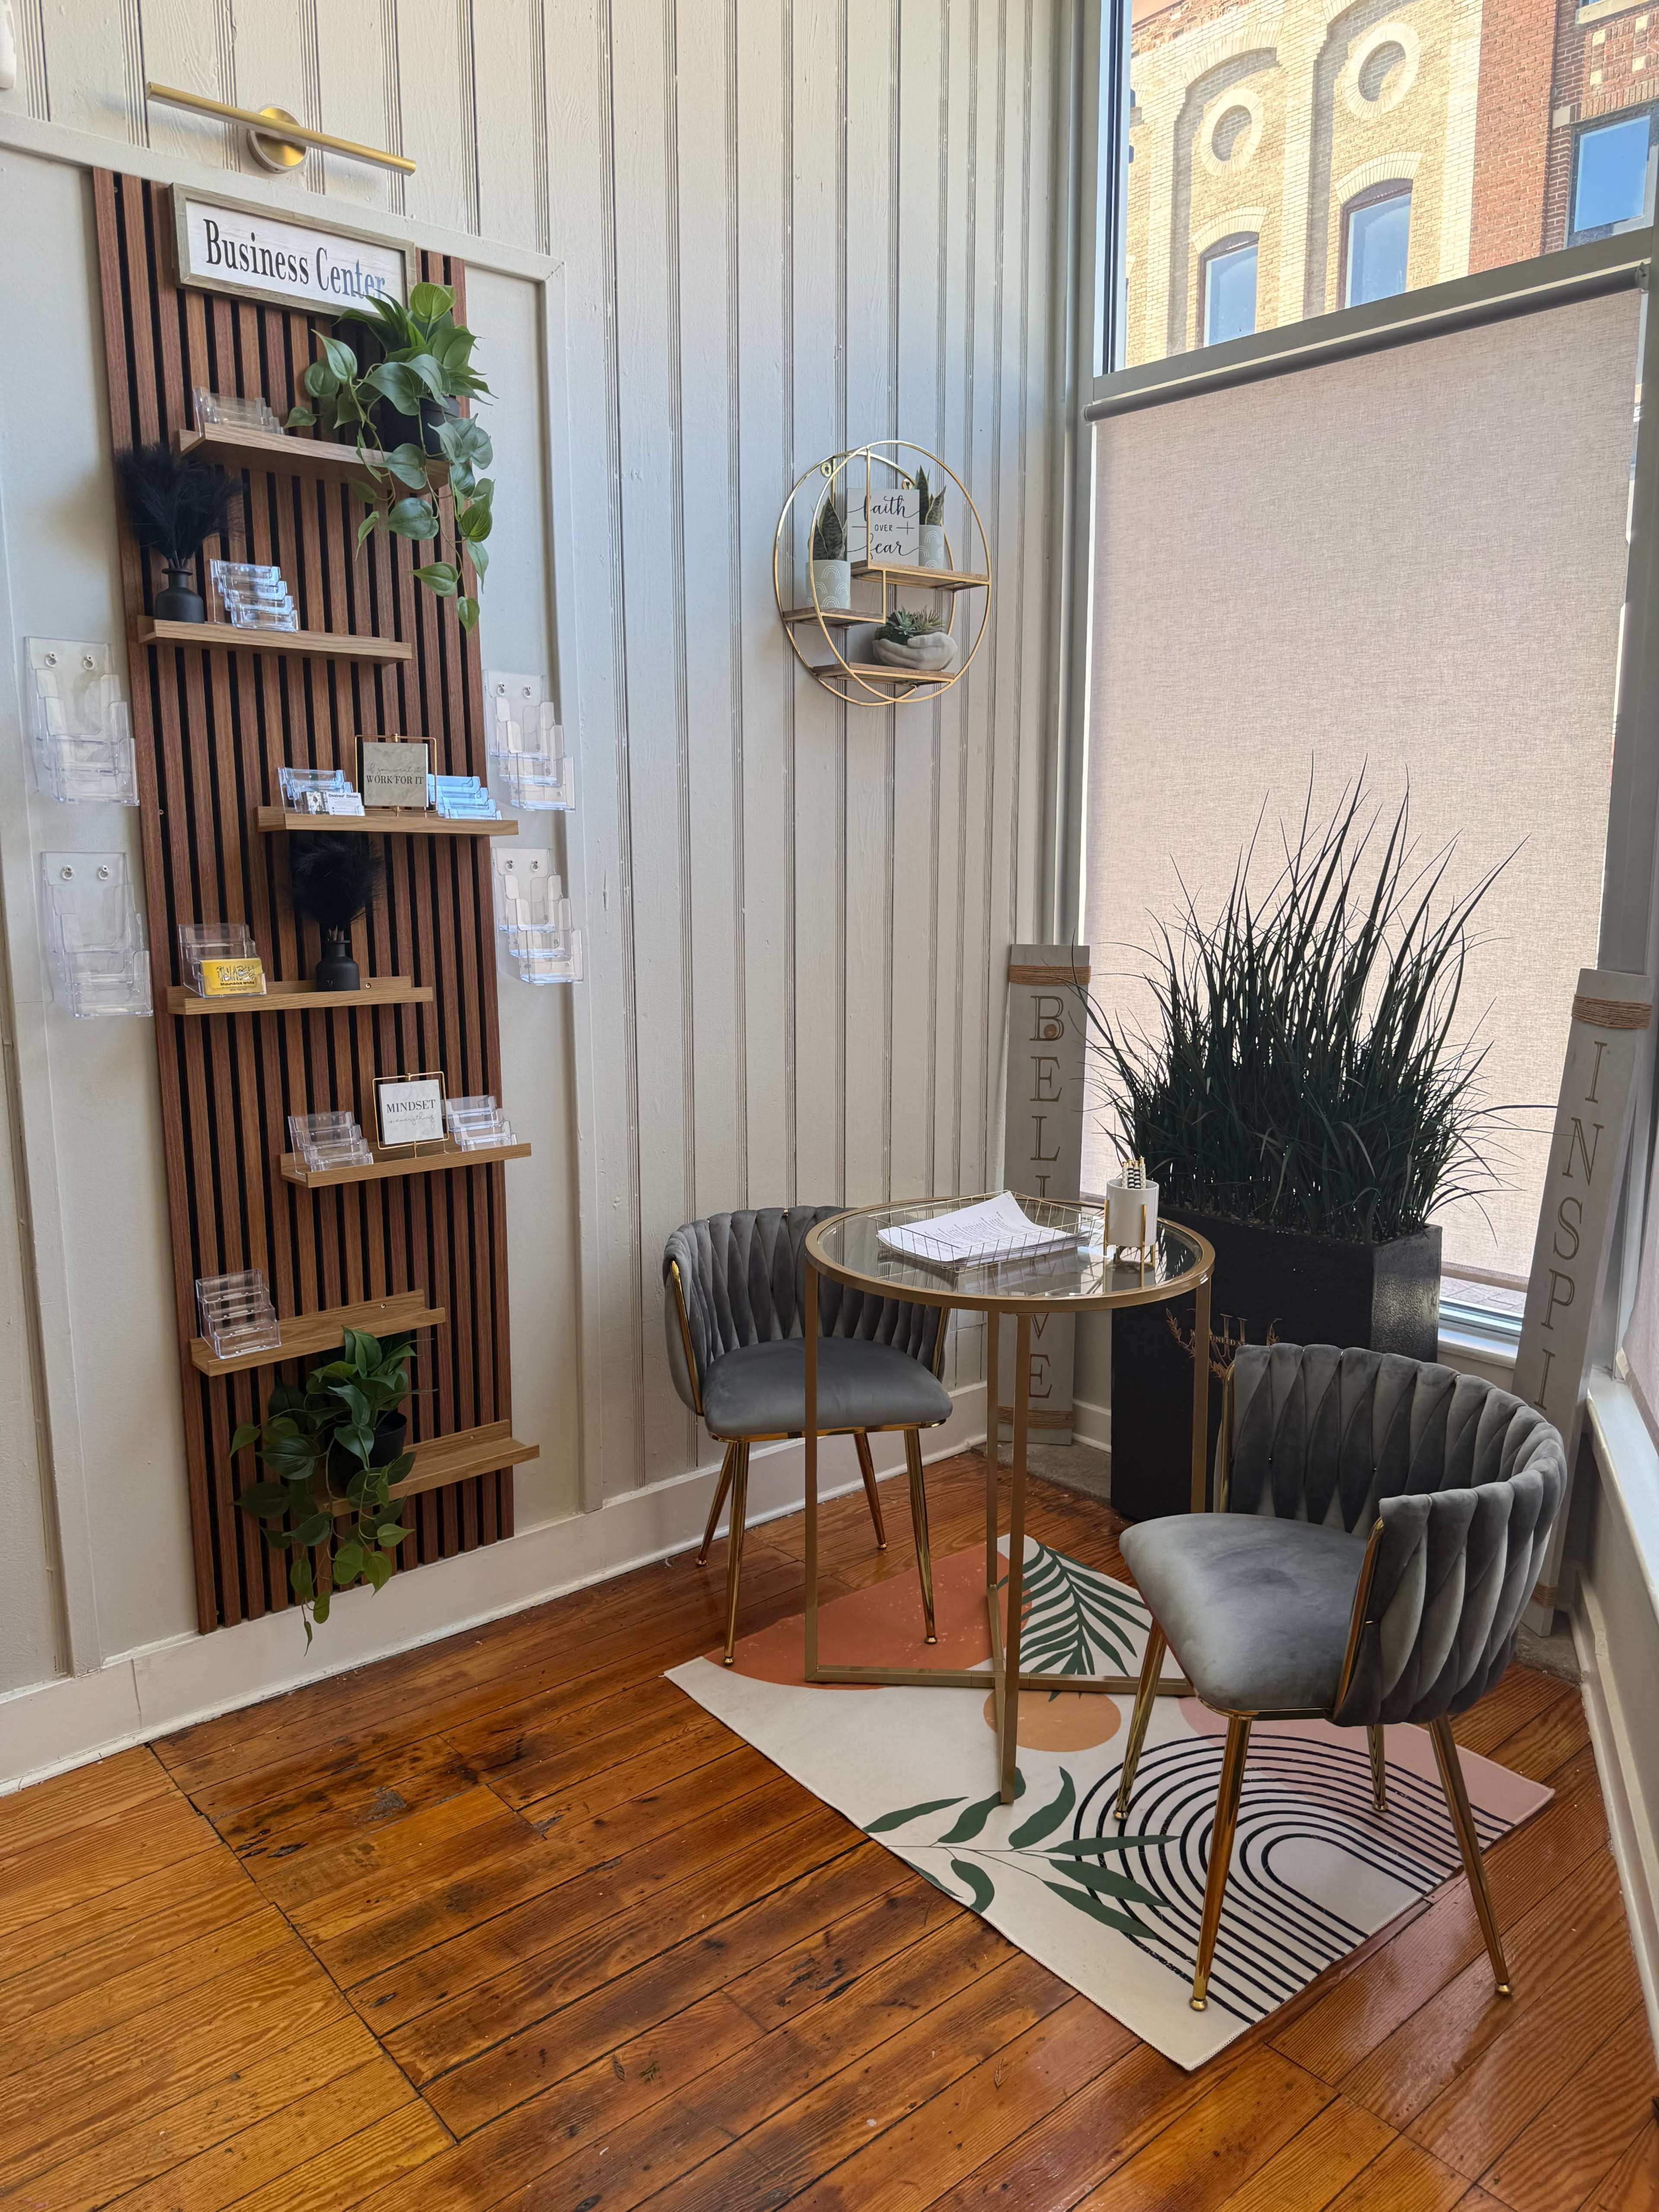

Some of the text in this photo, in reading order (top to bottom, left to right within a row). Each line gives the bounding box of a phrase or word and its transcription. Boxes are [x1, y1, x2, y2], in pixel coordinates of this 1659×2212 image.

[203, 219, 385, 299] Business Center
[366, 775, 424, 784] WORK FOR IT
[387, 1099, 435, 1113] MINDSET
